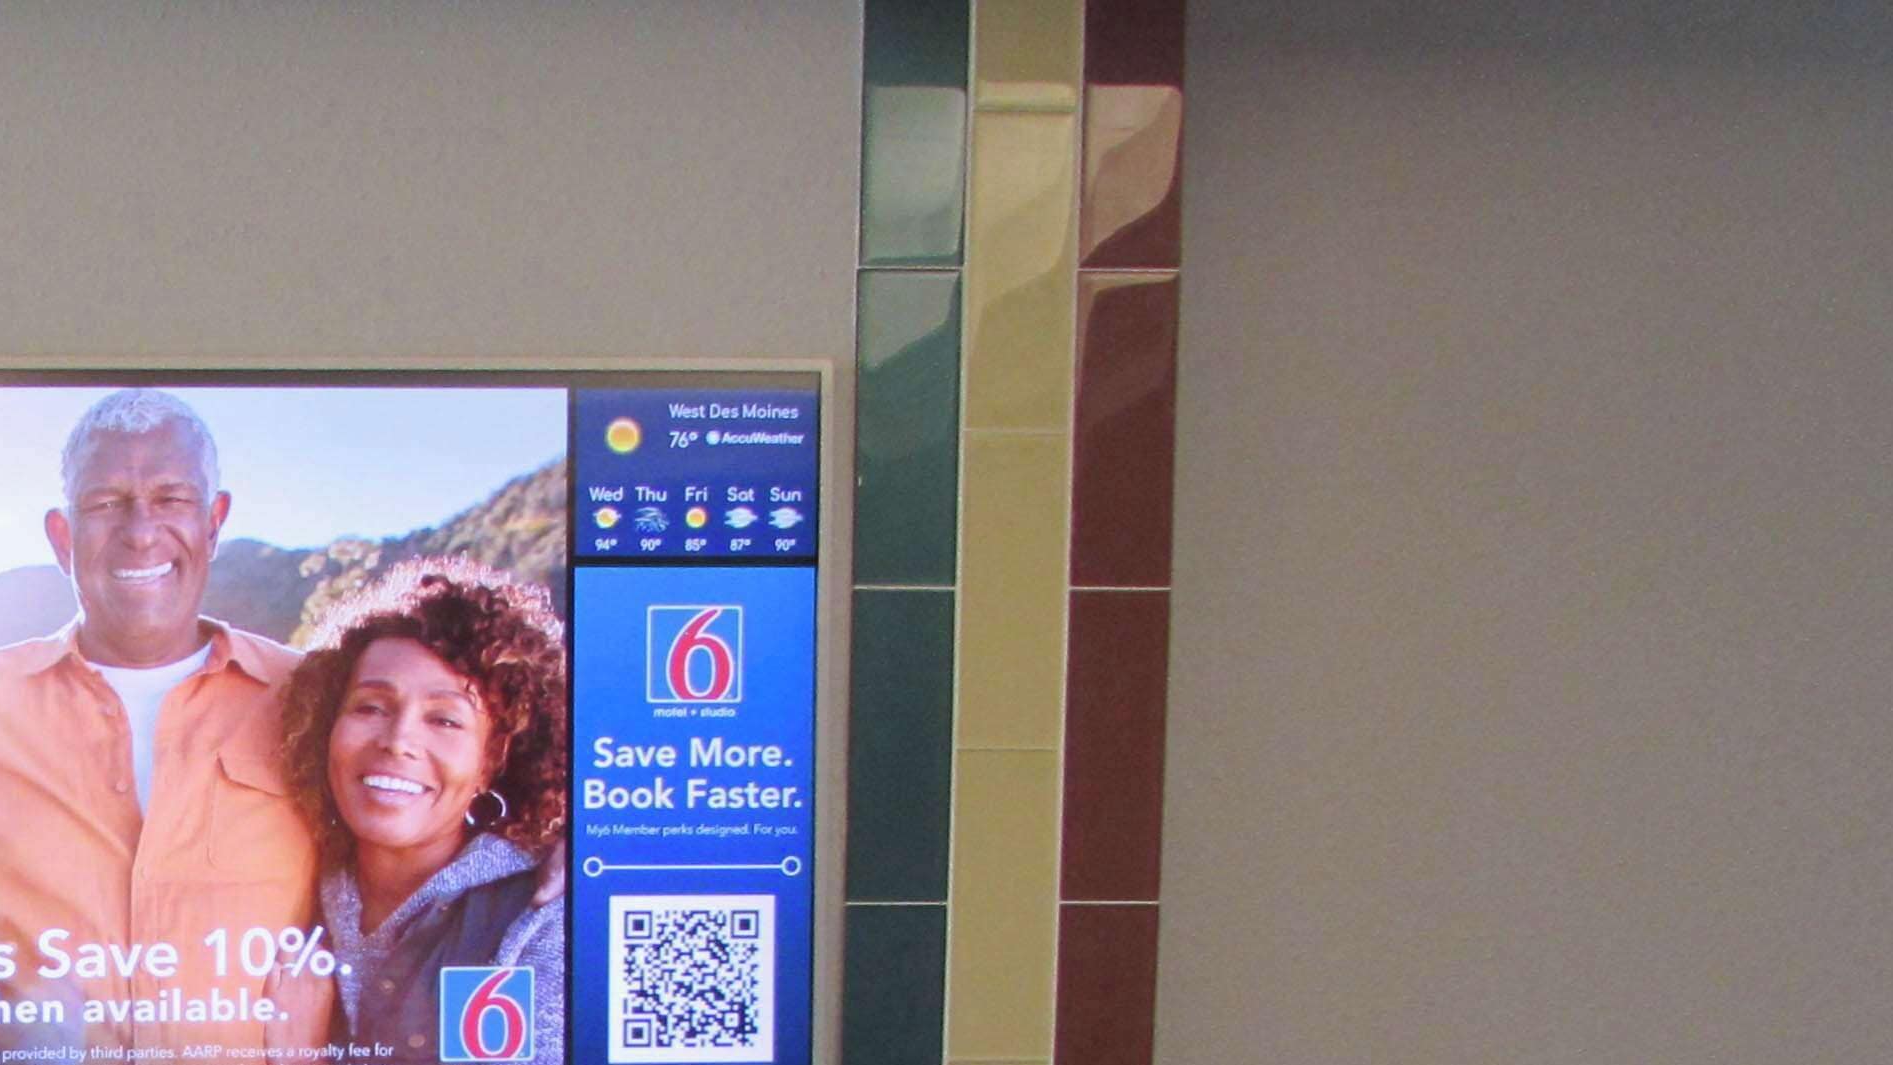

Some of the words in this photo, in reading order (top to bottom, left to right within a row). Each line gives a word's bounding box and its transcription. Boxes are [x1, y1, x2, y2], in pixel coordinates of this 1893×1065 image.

[669, 404, 705, 419] West
[710, 404, 739, 419] Des
[742, 404, 799, 419] Moines
[721, 432, 805, 445] AccuWeather
[589, 486, 623, 502] Wed
[635, 486, 667, 502] Thu
[685, 486, 708, 502] Fri
[727, 486, 755, 502] Sat
[770, 486, 802, 502] Sun
[666, 606, 734, 701] 6
[654, 707, 687, 718] motel
[593, 737, 677, 767] Save
[690, 738, 793, 767] More.
[583, 777, 674, 809] Book
[687, 778, 802, 809] Faster.
[613, 824, 659, 835] Member
[662, 824, 693, 837] perks
[754, 823, 772, 835] For
[37, 928, 179, 979] Save
[205, 926, 353, 978] 10%.
[83, 987, 289, 1023] available.
[460, 968, 526, 1060] 6
[2, 1046, 66, 1064] provided
[69, 1046, 85, 1063] by
[91, 1046, 123, 1059] third
[127, 1046, 175, 1062] parties.
[182, 1045, 222, 1058] AARP
[226, 1046, 283, 1058] receives
[286, 1048, 294, 1058] a
[298, 1043, 344, 1060] royalty
[348, 1043, 370, 1058] fee
[374, 1043, 394, 1057] for
